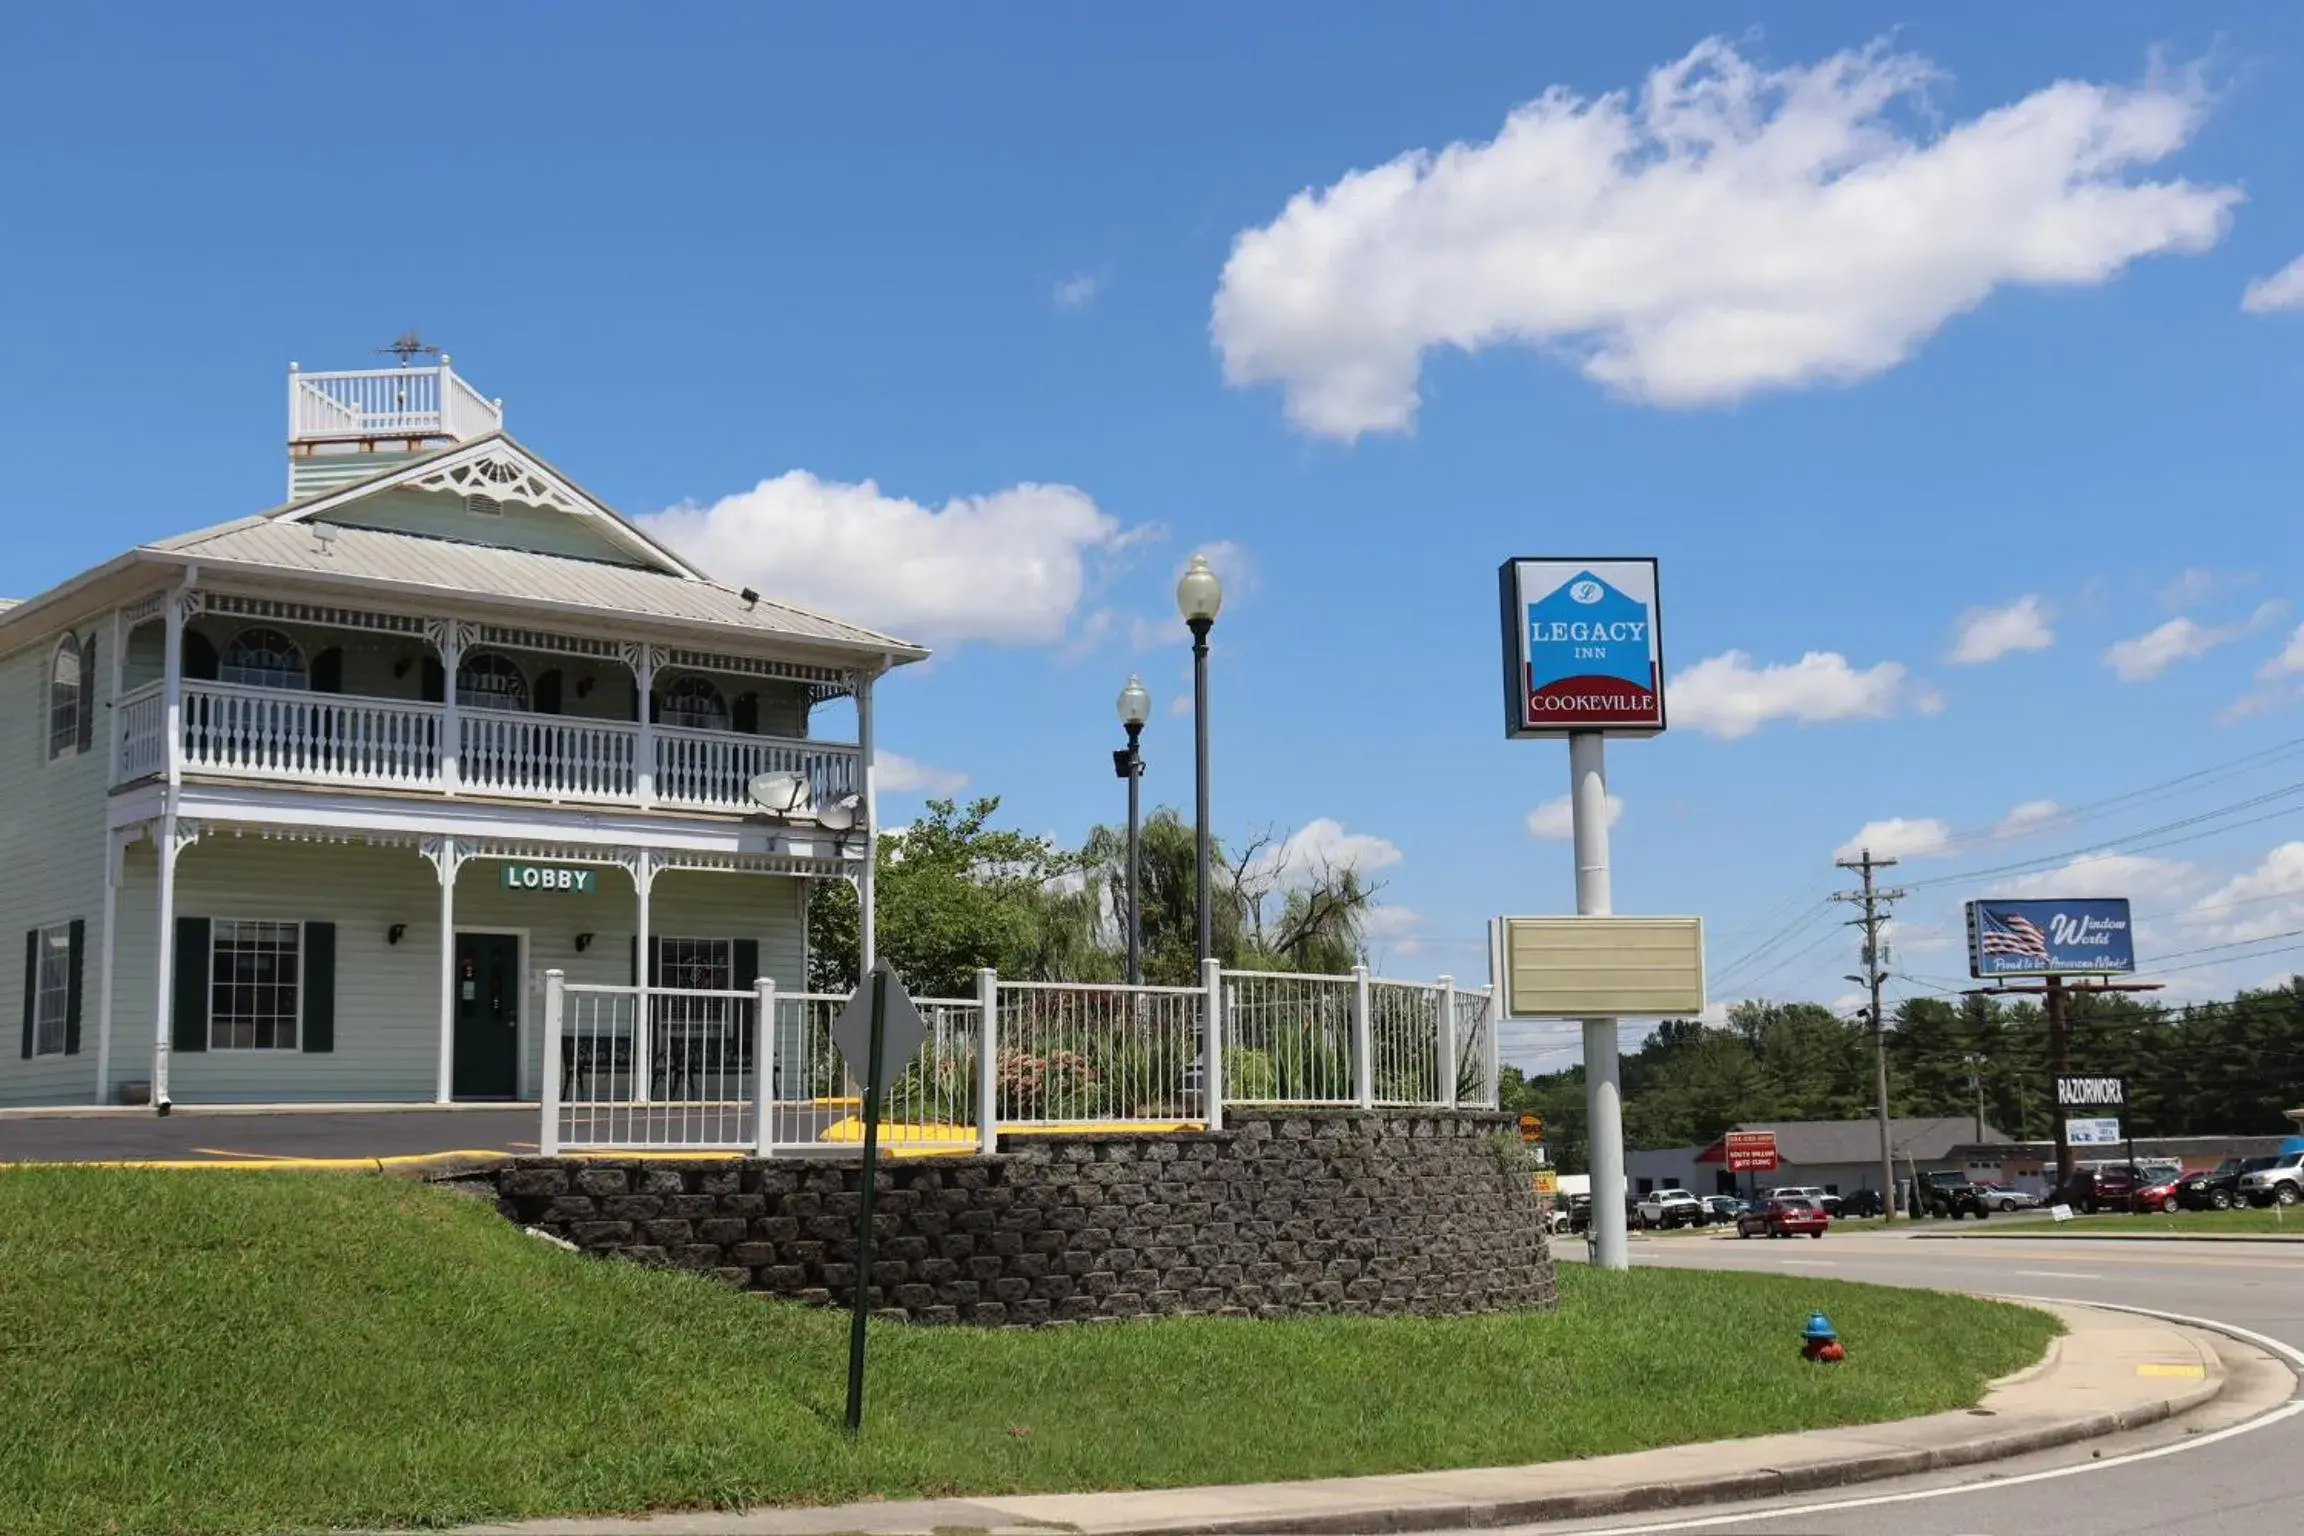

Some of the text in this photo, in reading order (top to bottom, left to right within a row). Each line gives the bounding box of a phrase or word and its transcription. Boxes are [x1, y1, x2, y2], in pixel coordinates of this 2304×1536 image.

[1531, 621, 1647, 642] LEGACY
[1574, 647, 1607, 660] INN
[1531, 695, 1654, 711] COOKEVILLE
[508, 866, 588, 890] LOBBY
[2050, 913, 2126, 945] Window
[2057, 1077, 2124, 1104] RAZORWORX
